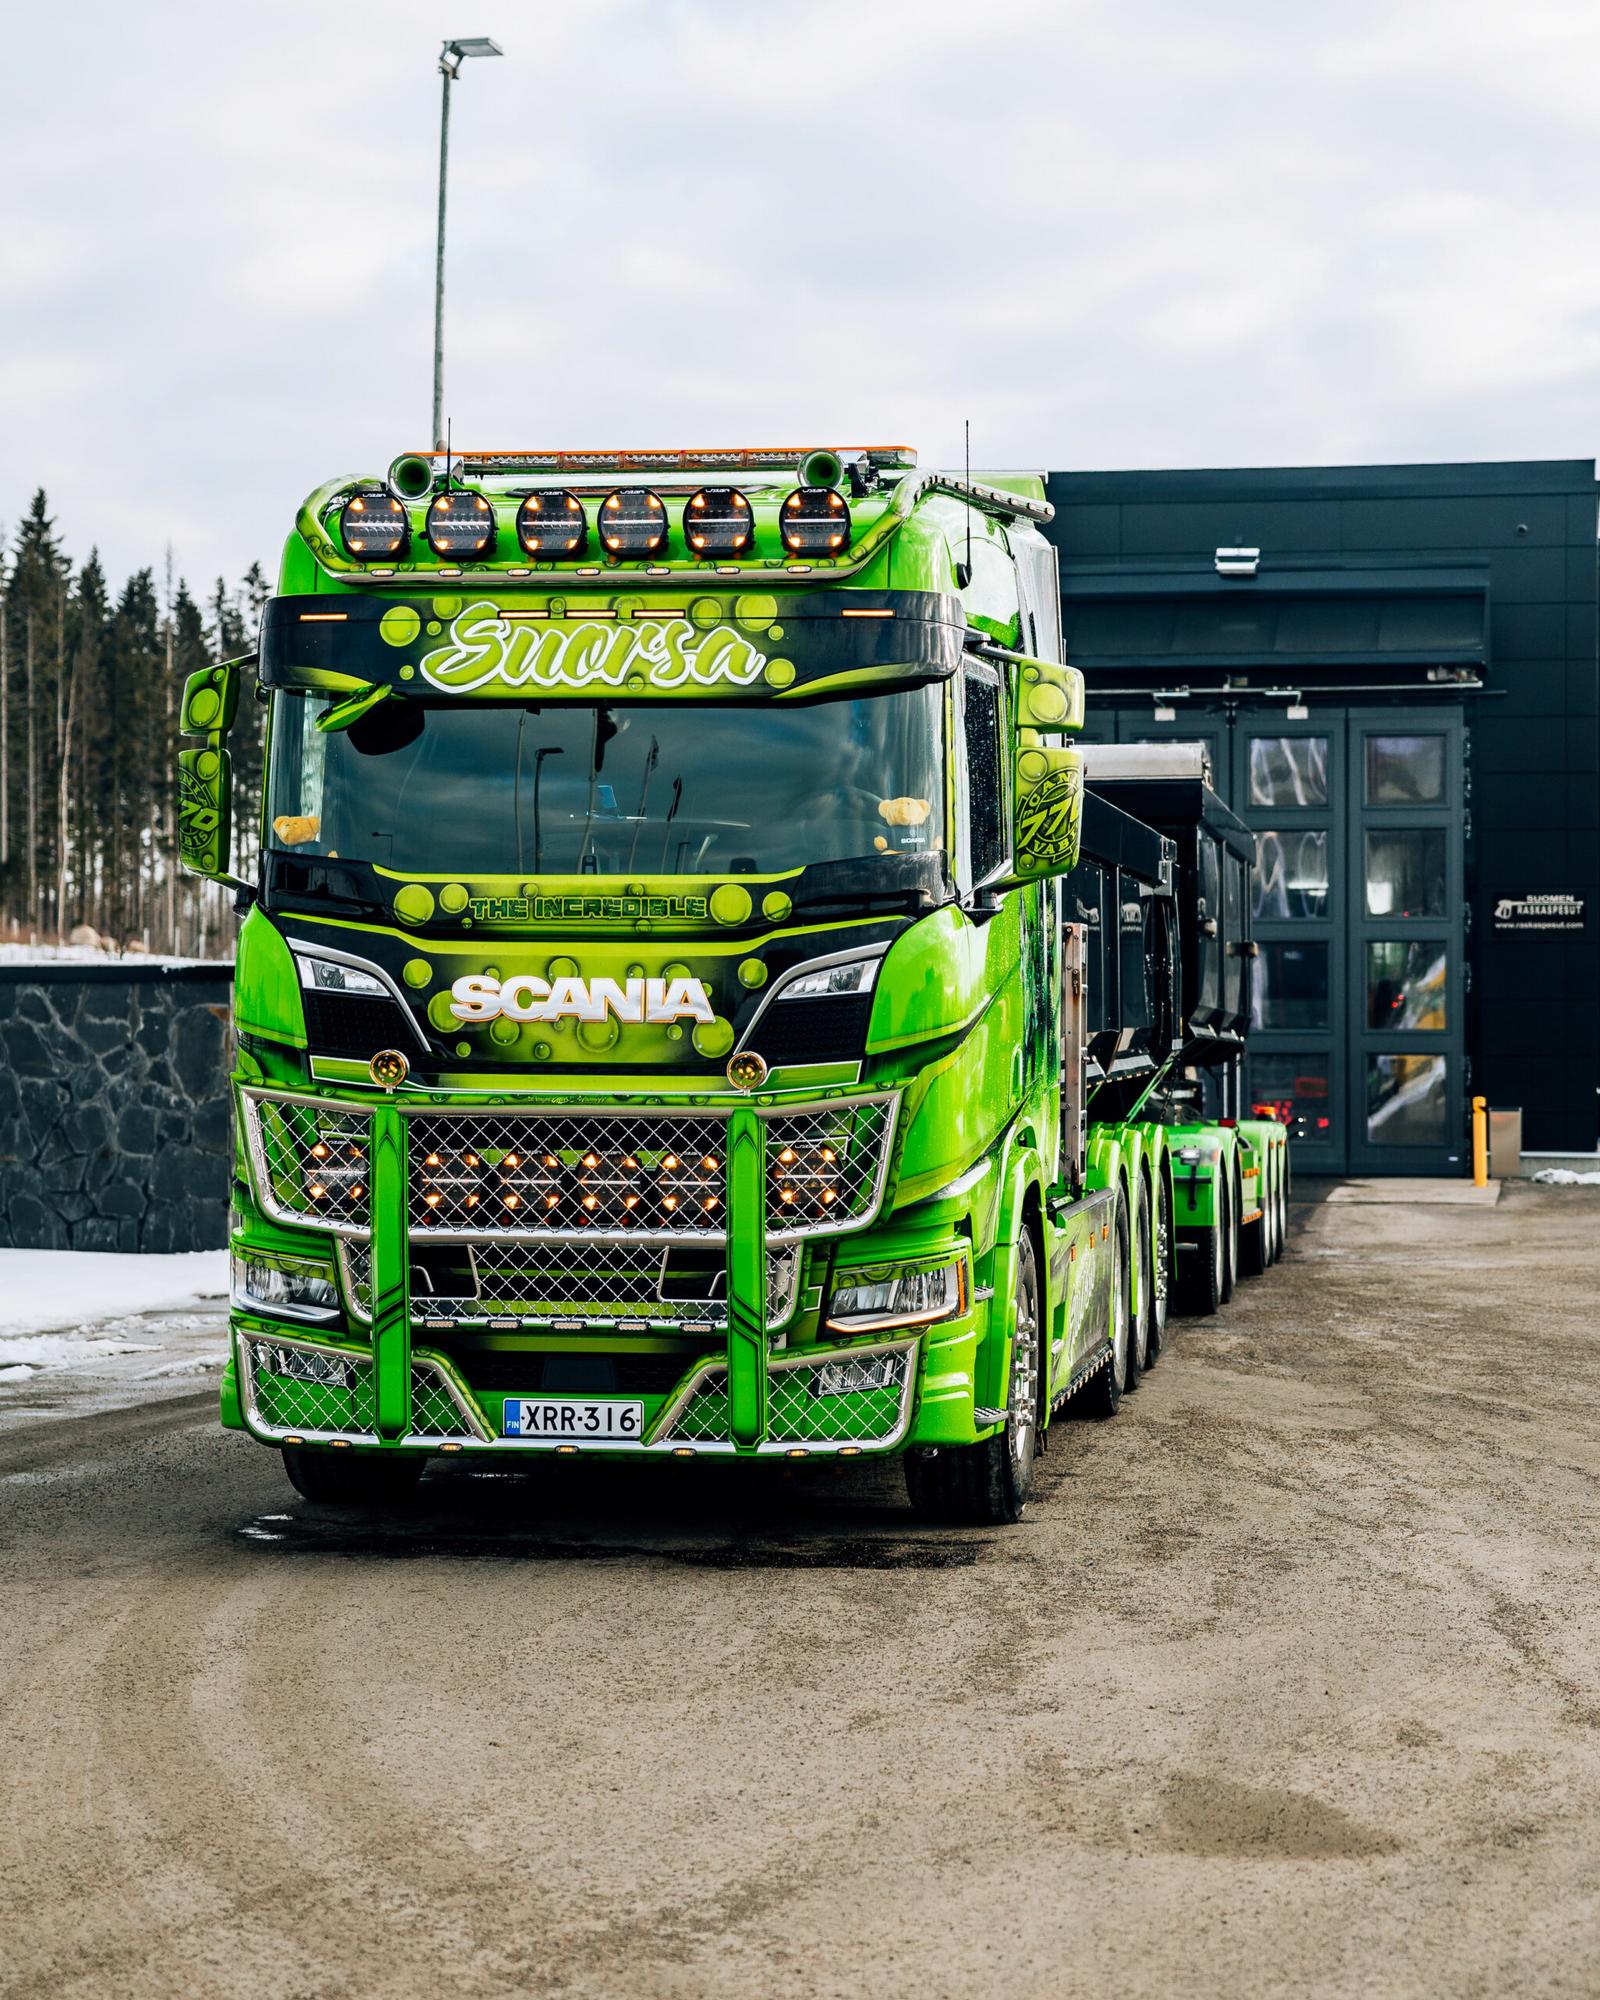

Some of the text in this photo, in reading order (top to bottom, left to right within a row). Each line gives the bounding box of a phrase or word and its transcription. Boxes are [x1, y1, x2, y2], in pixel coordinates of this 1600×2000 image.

[469, 896, 708, 921] THE INCREDIBLE
[449, 974, 717, 1024] SCANIA
[506, 1405, 637, 1432] FIN XRR-316
